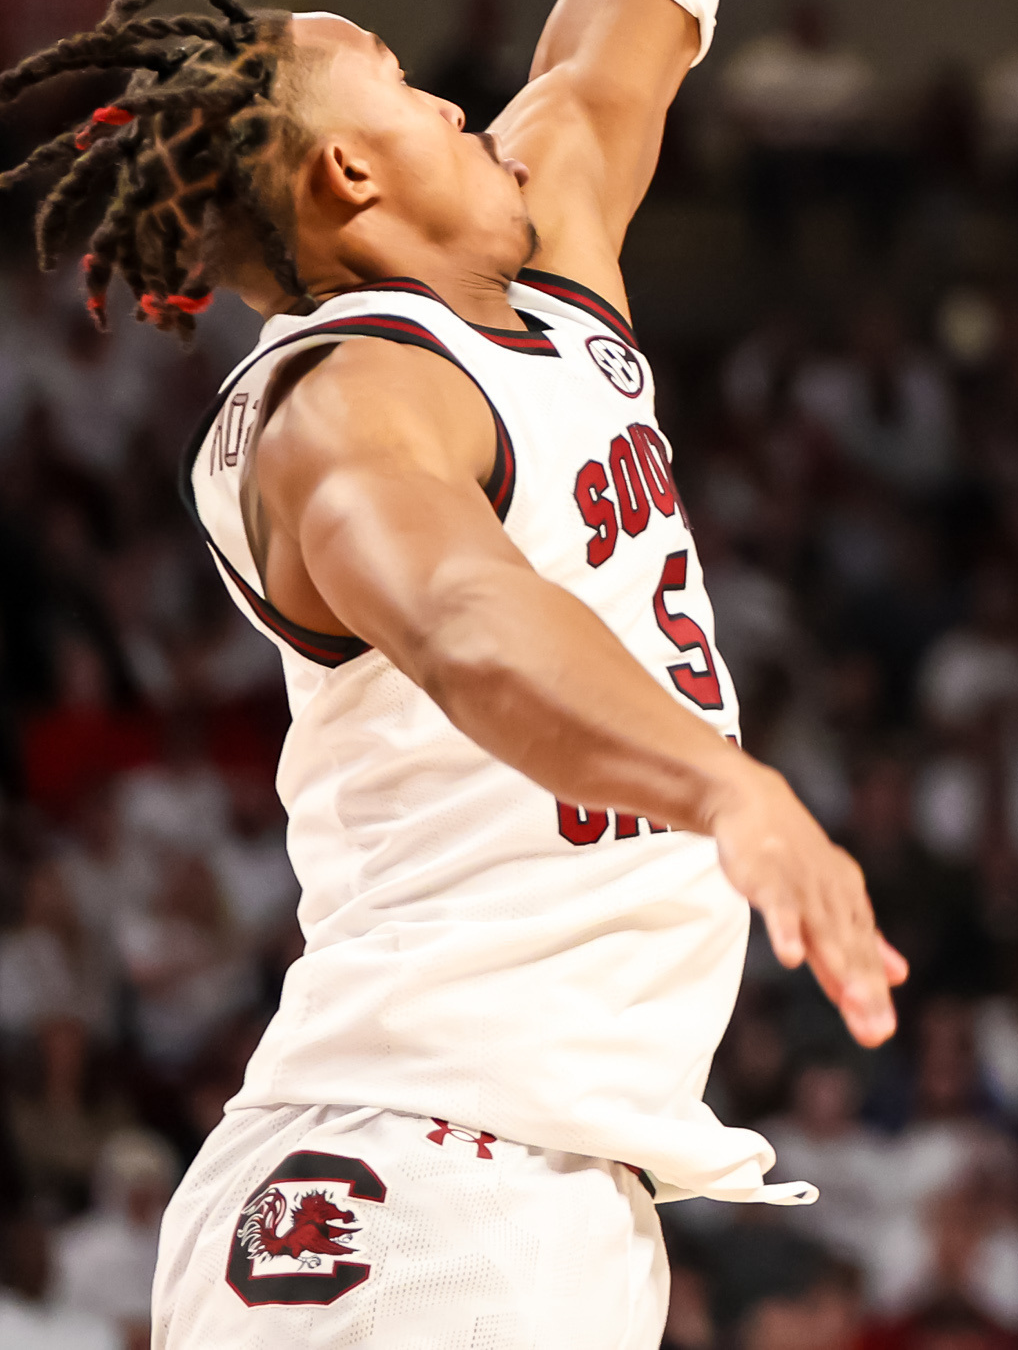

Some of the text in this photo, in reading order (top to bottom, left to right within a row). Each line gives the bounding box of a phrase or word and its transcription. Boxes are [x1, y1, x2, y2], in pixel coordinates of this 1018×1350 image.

[586, 337, 643, 396] SEC
[573, 421, 694, 571] SOU
[653, 548, 724, 711] 5
